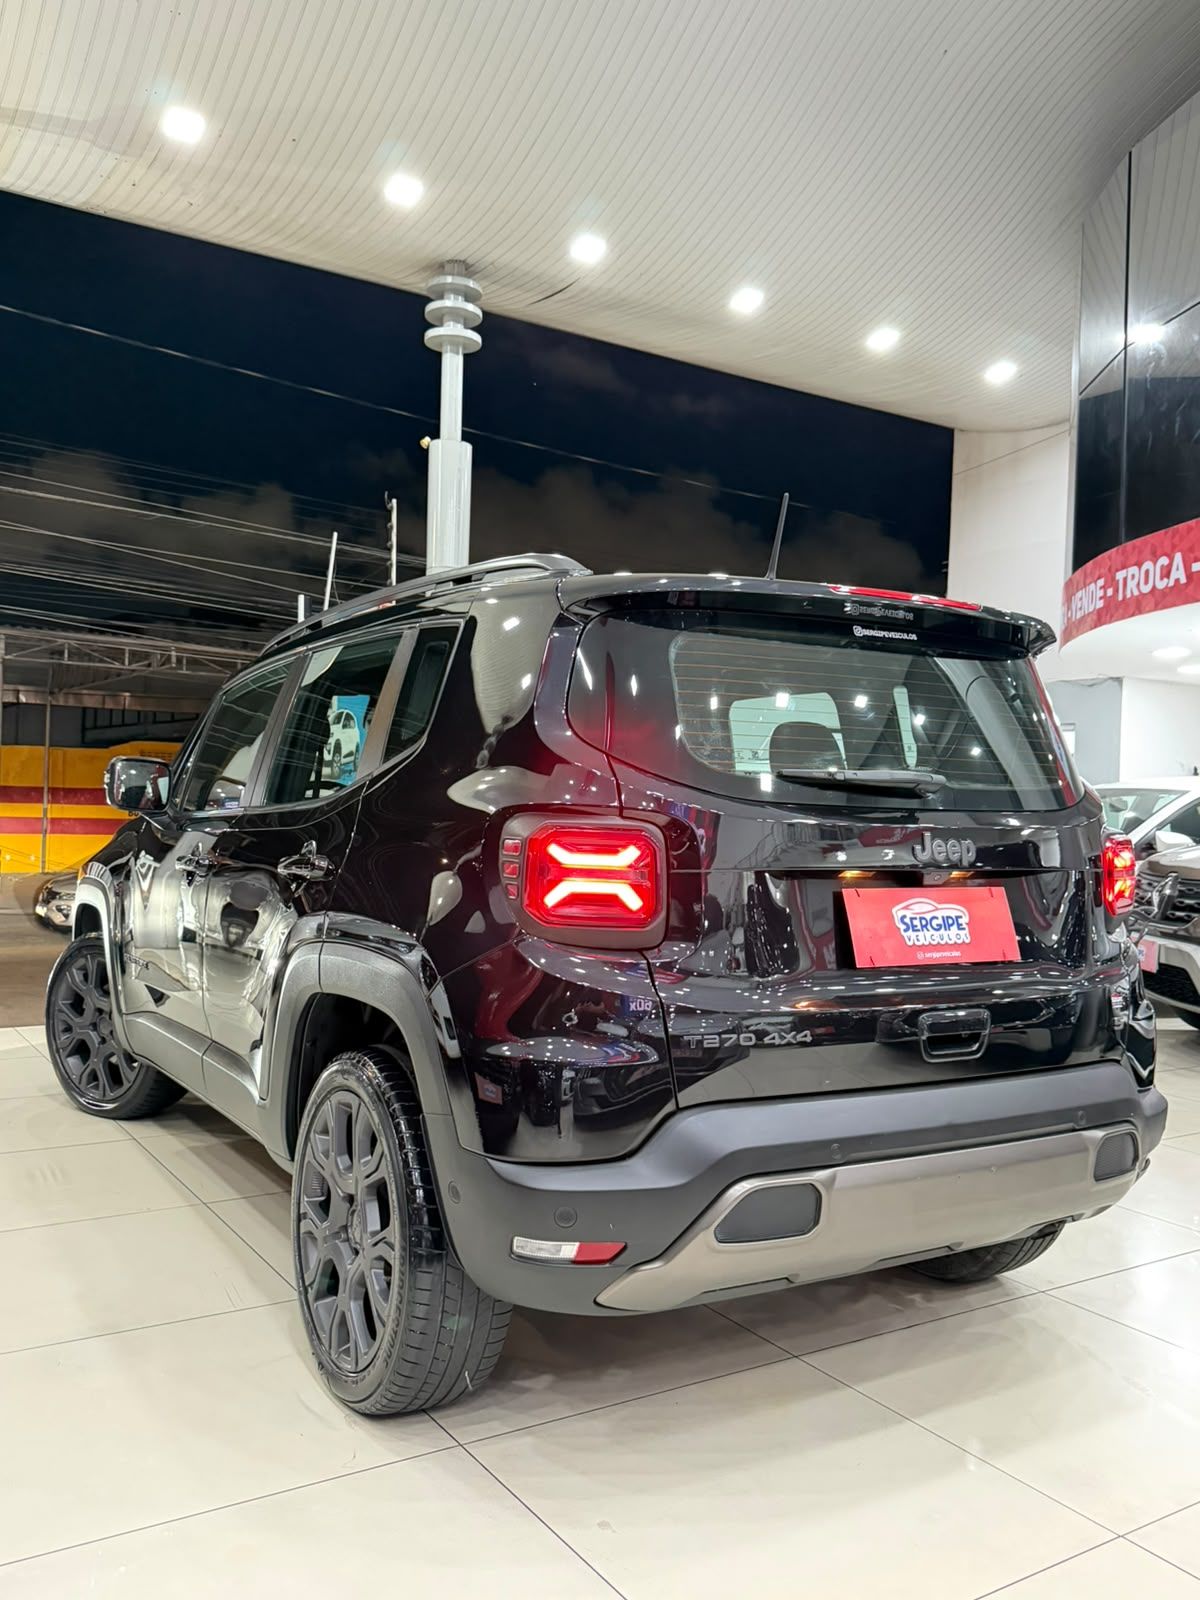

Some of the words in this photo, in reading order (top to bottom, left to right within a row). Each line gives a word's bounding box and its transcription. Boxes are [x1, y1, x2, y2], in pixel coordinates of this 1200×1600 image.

[1071, 577, 1105, 622] VENDE
[1115, 551, 1188, 602] TROCA
[913, 831, 977, 867] Jeep
[900, 914, 966, 933] SERGIPE
[683, 1033, 757, 1049] T270
